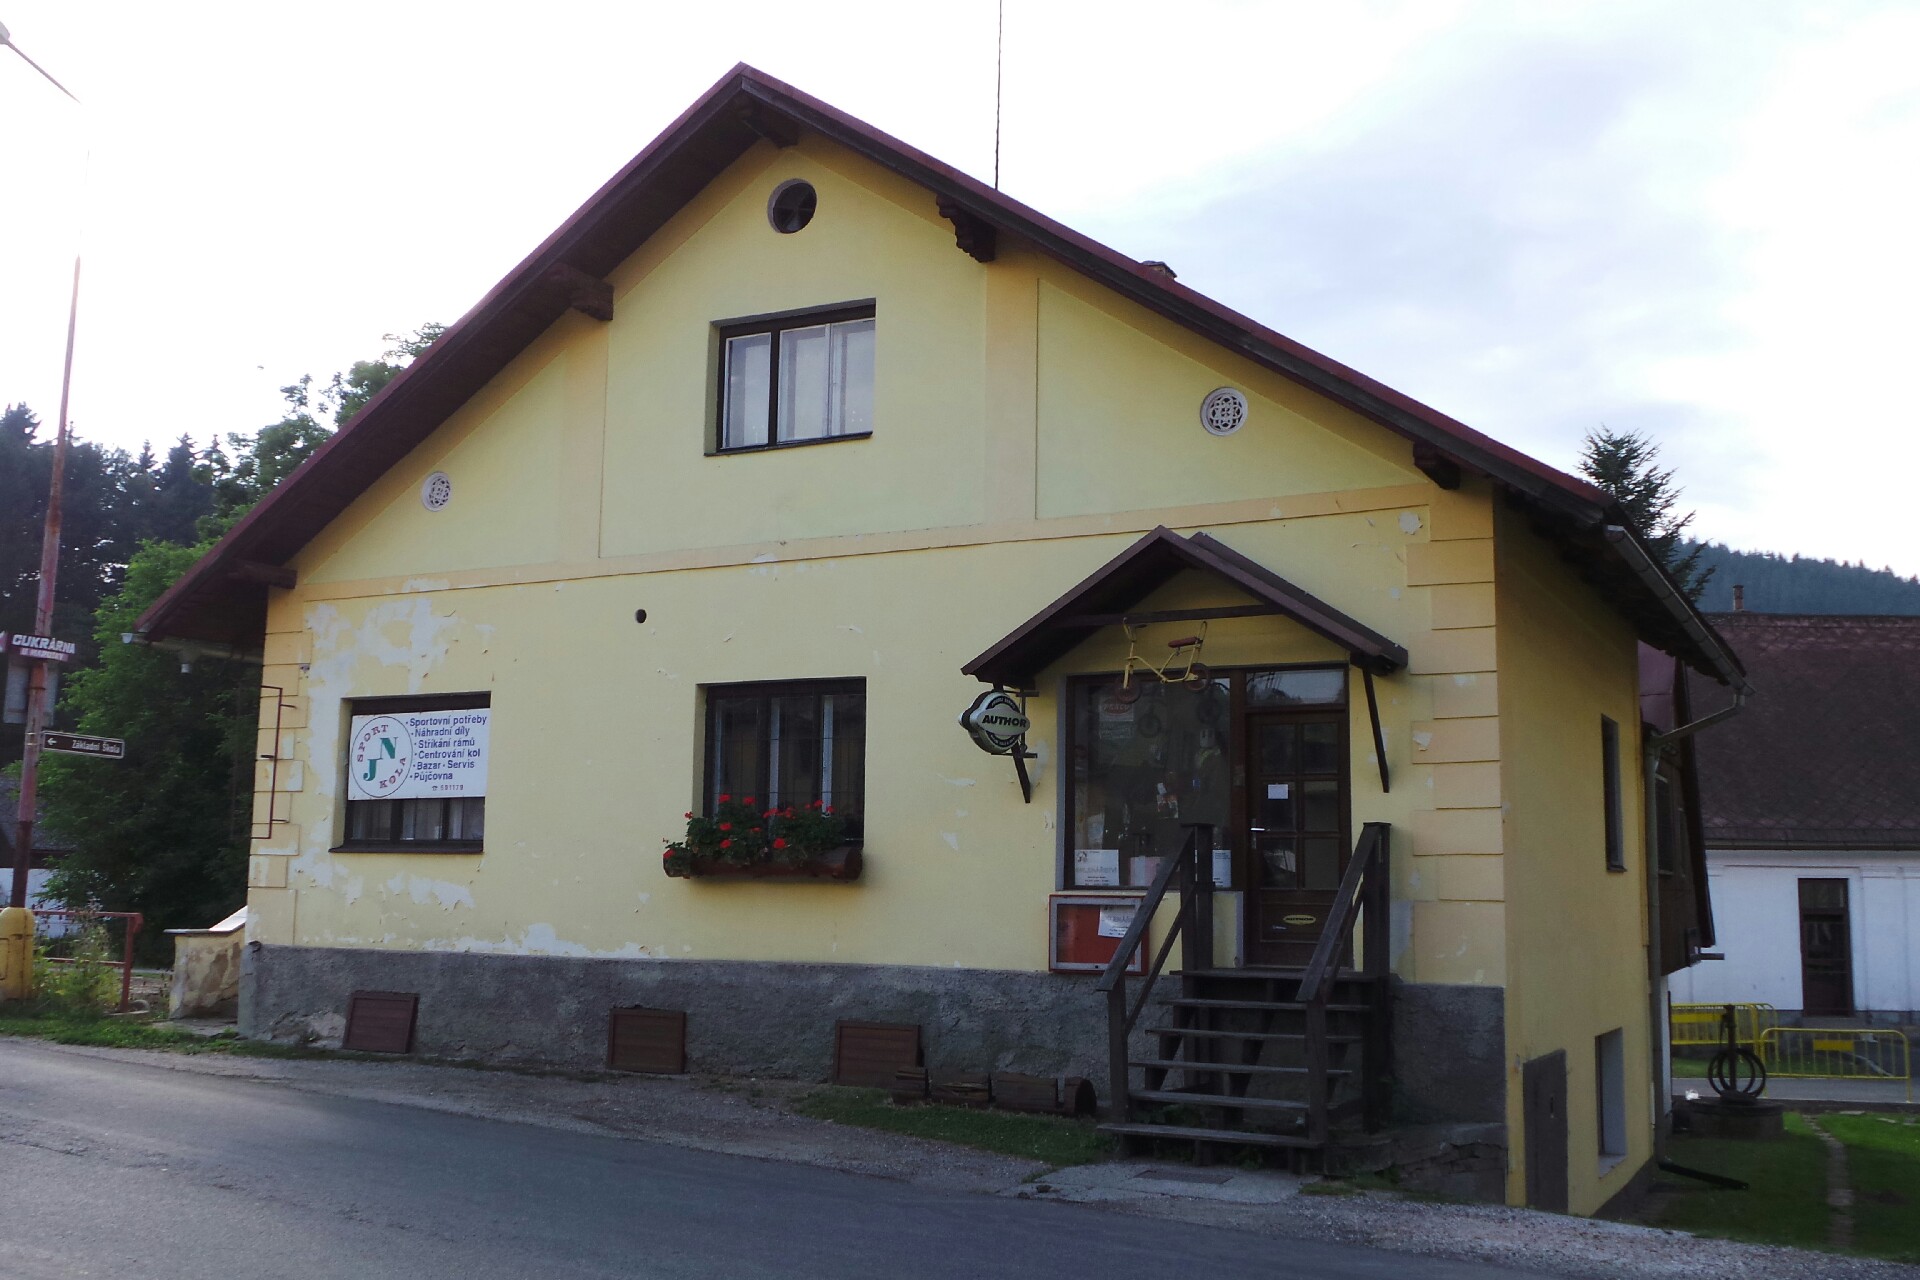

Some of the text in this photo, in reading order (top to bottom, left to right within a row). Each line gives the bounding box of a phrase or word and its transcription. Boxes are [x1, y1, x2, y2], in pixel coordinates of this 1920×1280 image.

[12, 634, 76, 654] CUKRÁRNA
[409, 714, 487, 729] Sportovní potřeby
[981, 714, 1027, 728] AUTHOR
[414, 725, 470, 737] Náhradní díly
[72, 739, 120, 754] Základní Škola
[357, 724, 388, 762] SPORT
[418, 737, 475, 749] Stříkání rámů
[418, 748, 480, 760] Centrování kol
[417, 759, 475, 771] Bazar Servis
[379, 757, 406, 788] KOLA
[413, 771, 453, 782] Půjčovna
